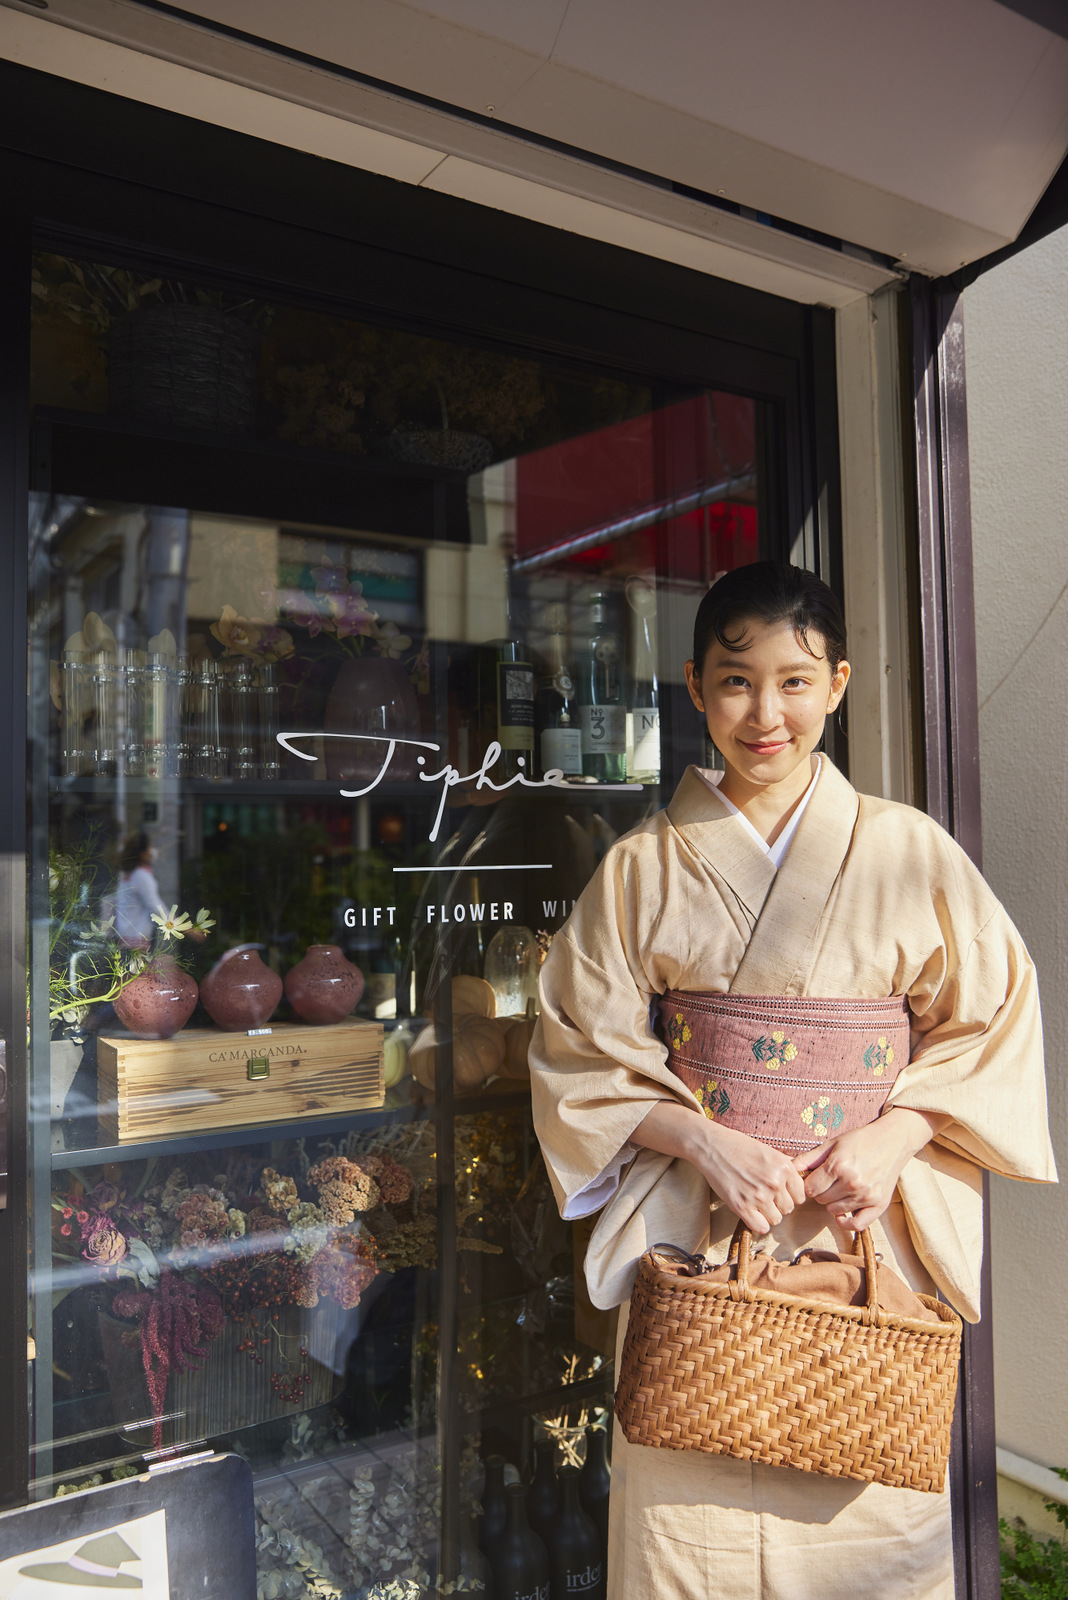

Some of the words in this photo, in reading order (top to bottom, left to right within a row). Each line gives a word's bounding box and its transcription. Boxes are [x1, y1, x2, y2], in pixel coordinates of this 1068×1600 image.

[590, 717, 605, 739] 3
[276, 732, 644, 842] Tiphie
[344, 906, 396, 928] GIFT
[427, 902, 514, 923] FLOWER
[542, 900, 576, 918] WI
